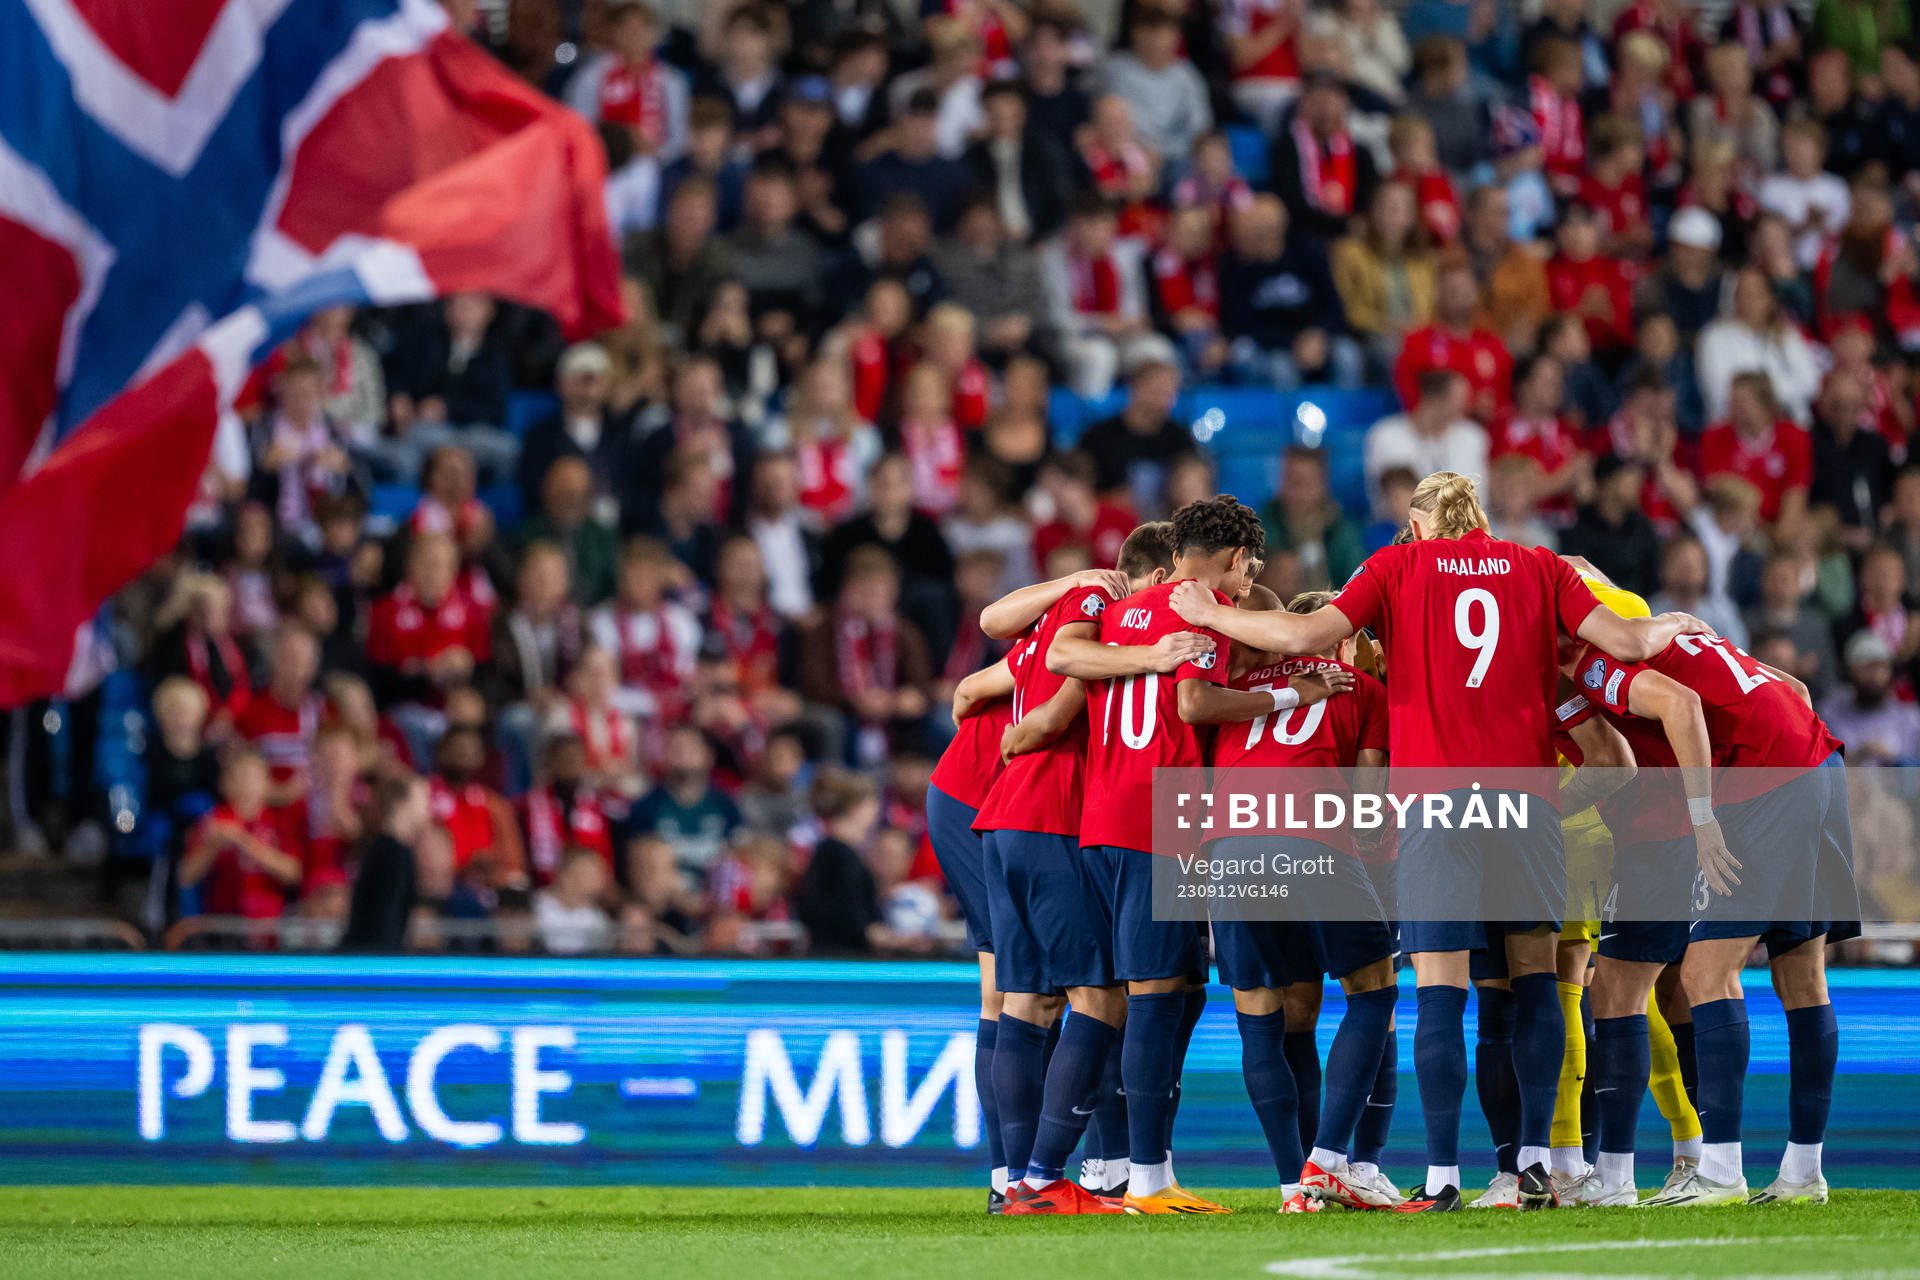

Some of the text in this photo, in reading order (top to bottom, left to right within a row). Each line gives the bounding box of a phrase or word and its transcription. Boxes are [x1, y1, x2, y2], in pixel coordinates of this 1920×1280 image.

[1436, 557, 1511, 576] HAALAND
[1120, 608, 1152, 630] NUSA
[1454, 587, 1500, 688] 9
[137, 1023, 587, 1147] PEACE
